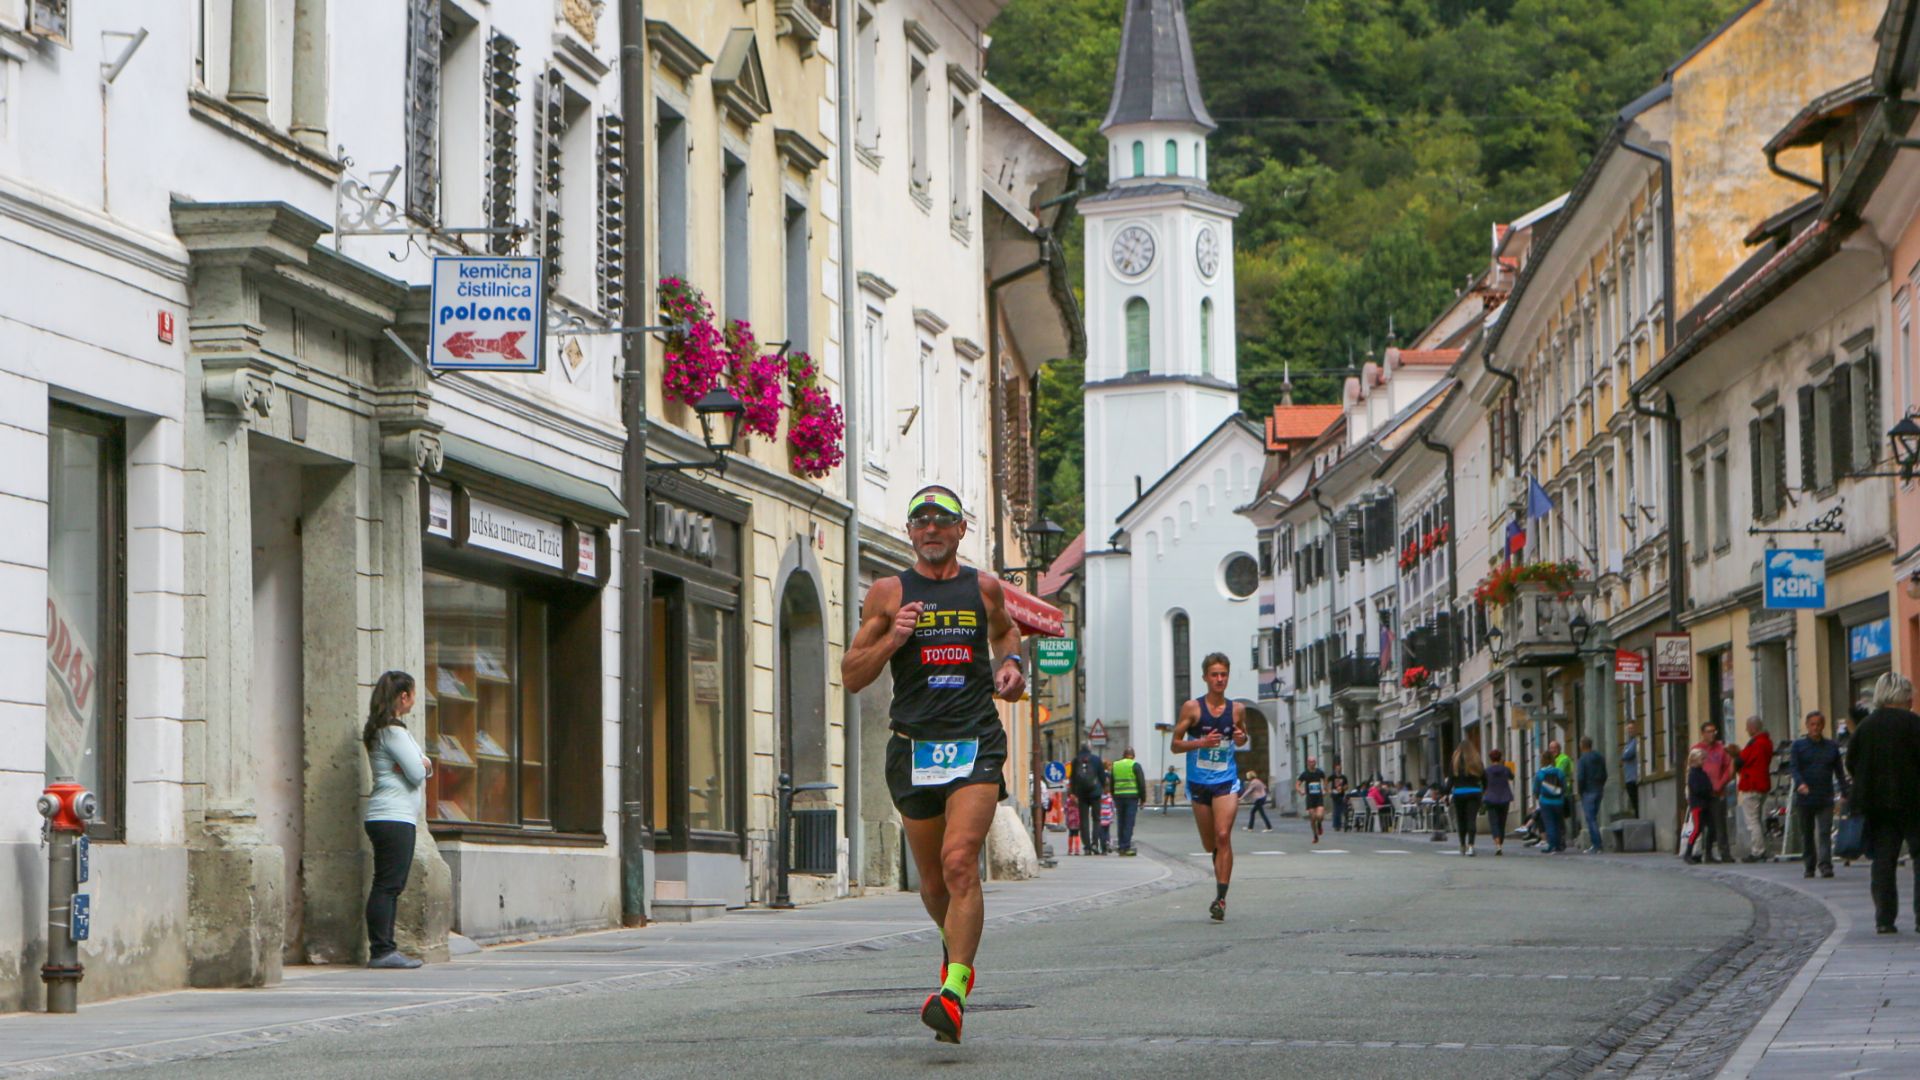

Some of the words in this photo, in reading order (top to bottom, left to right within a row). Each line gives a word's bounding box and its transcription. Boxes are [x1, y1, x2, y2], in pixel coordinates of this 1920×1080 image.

[459, 263, 532, 279] kemična
[457, 281, 531, 297] čistilnica
[440, 302, 531, 325] polonca
[500, 521, 536, 550] univerza
[915, 628, 976, 637] COMPANY
[924, 648, 970, 662] TOYODA
[932, 743, 958, 764] 69
[1208, 750, 1221, 761] 15
